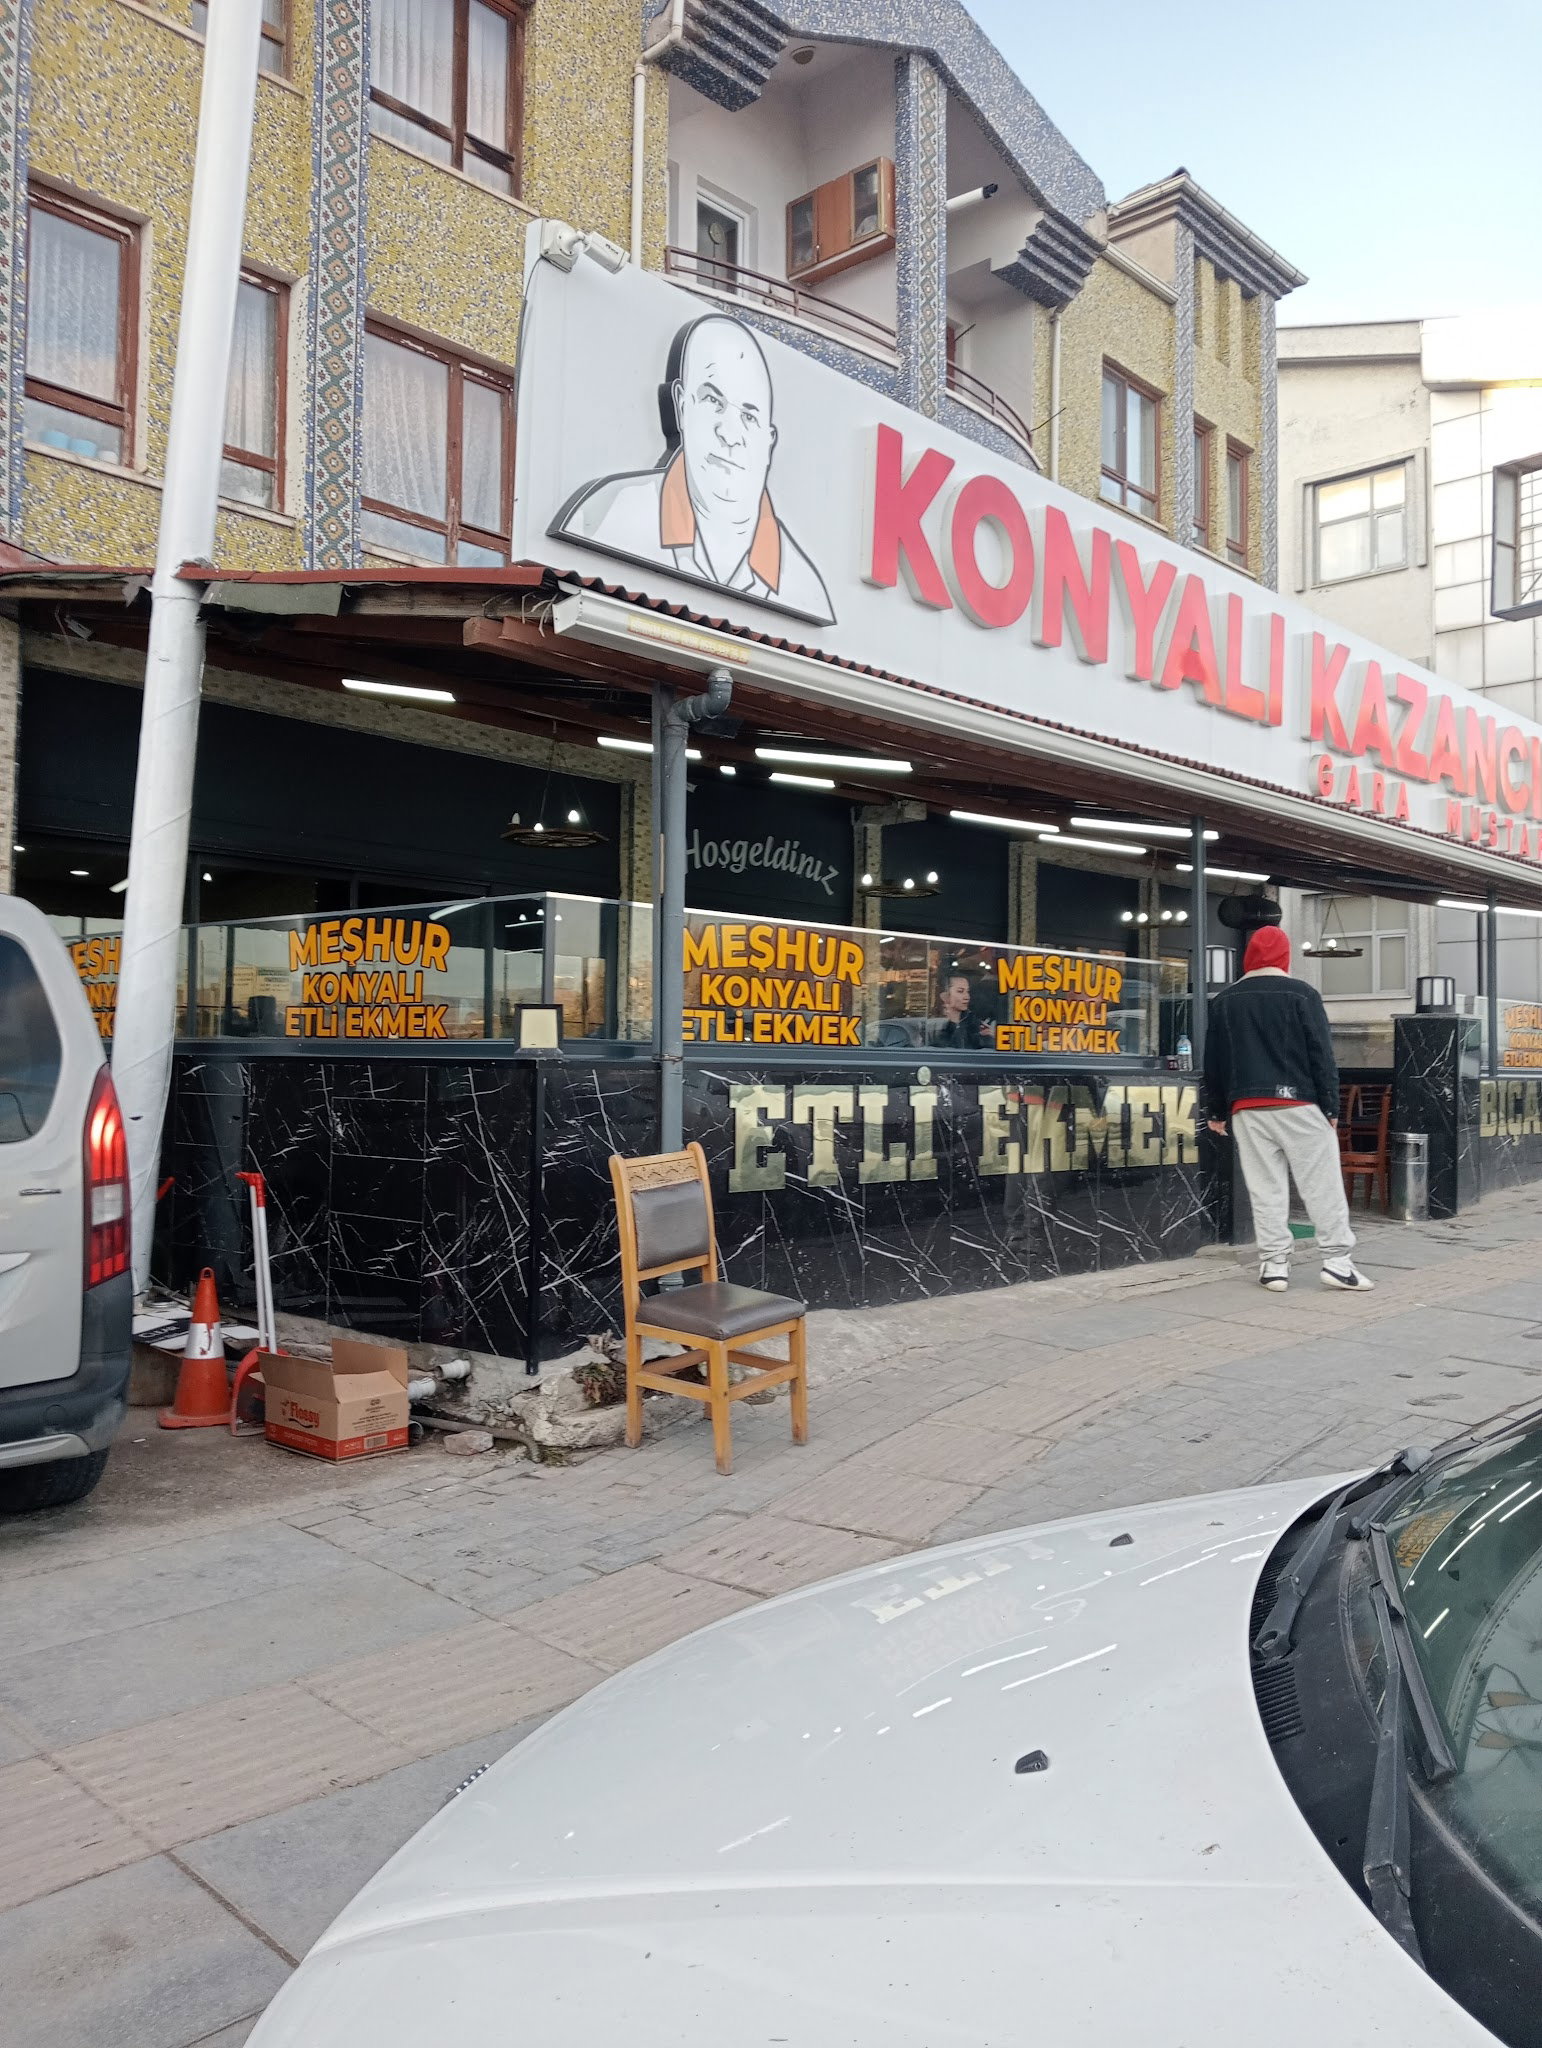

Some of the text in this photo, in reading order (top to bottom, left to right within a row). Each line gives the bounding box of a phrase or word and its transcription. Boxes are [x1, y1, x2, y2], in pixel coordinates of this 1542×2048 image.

[866, 422, 1542, 822] KONYALI KAZANCI
[1315, 753, 1411, 822] GARA
[288, 916, 451, 972] MEŞHUR
[682, 922, 866, 987] MEŞHUR
[302, 970, 424, 1005] KONYALI
[700, 972, 842, 1023] KONYALI
[997, 954, 1122, 1004] MEŞHUR
[344, 1004, 449, 1039] EKMEK
[752, 1010, 862, 1047] EKMEK
[1013, 995, 1107, 1026] KONYALI
[1047, 1026, 1121, 1054] EKMEK
[728, 1065, 1199, 1192] ETLİ EKMEK
